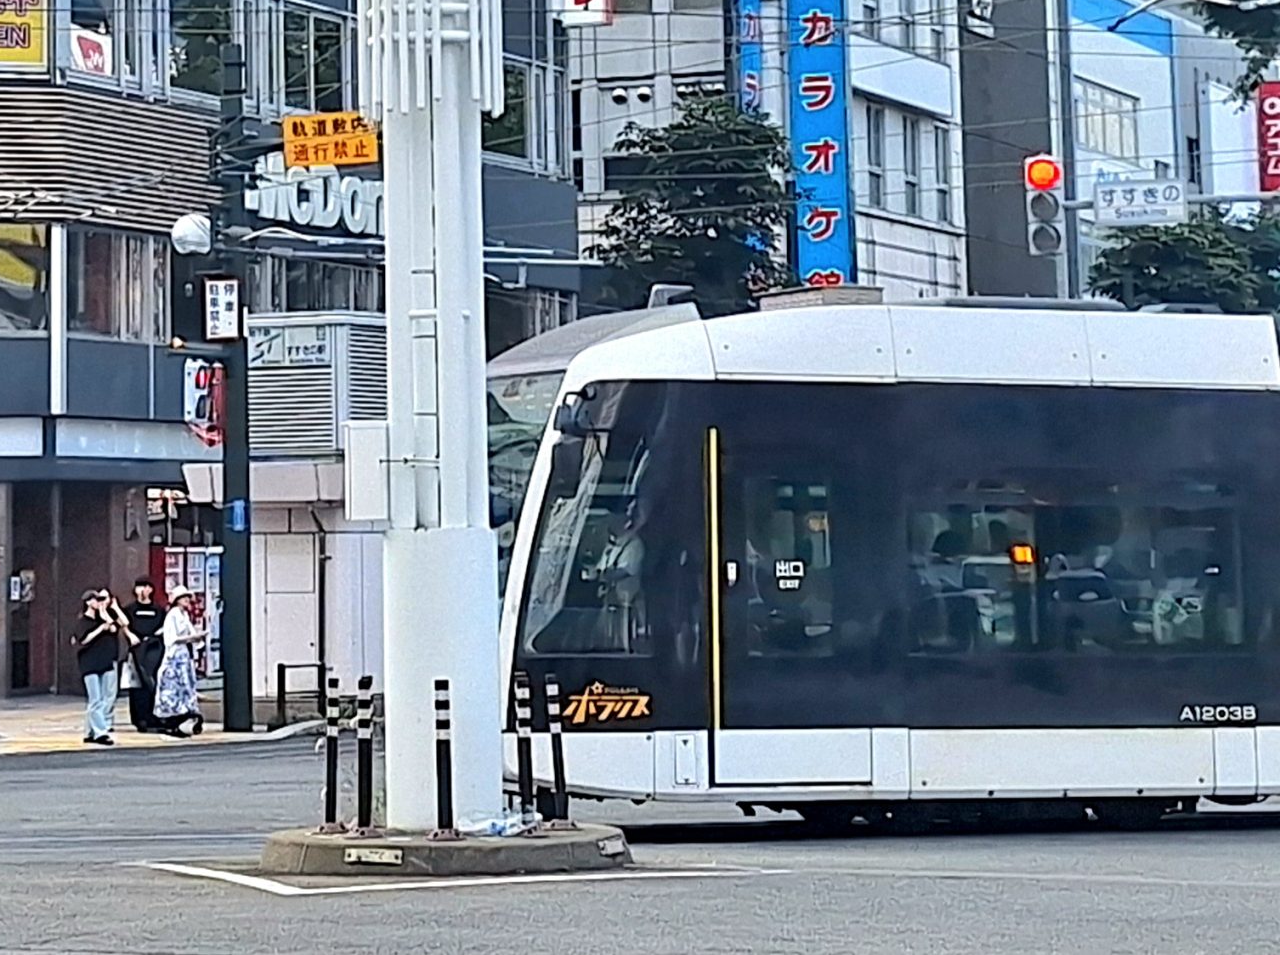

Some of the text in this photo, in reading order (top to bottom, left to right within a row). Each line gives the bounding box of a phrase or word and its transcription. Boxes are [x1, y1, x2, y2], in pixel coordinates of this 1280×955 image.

[1100, 184, 1180, 207] すすきの
[1179, 705, 1257, 722] A1203B
